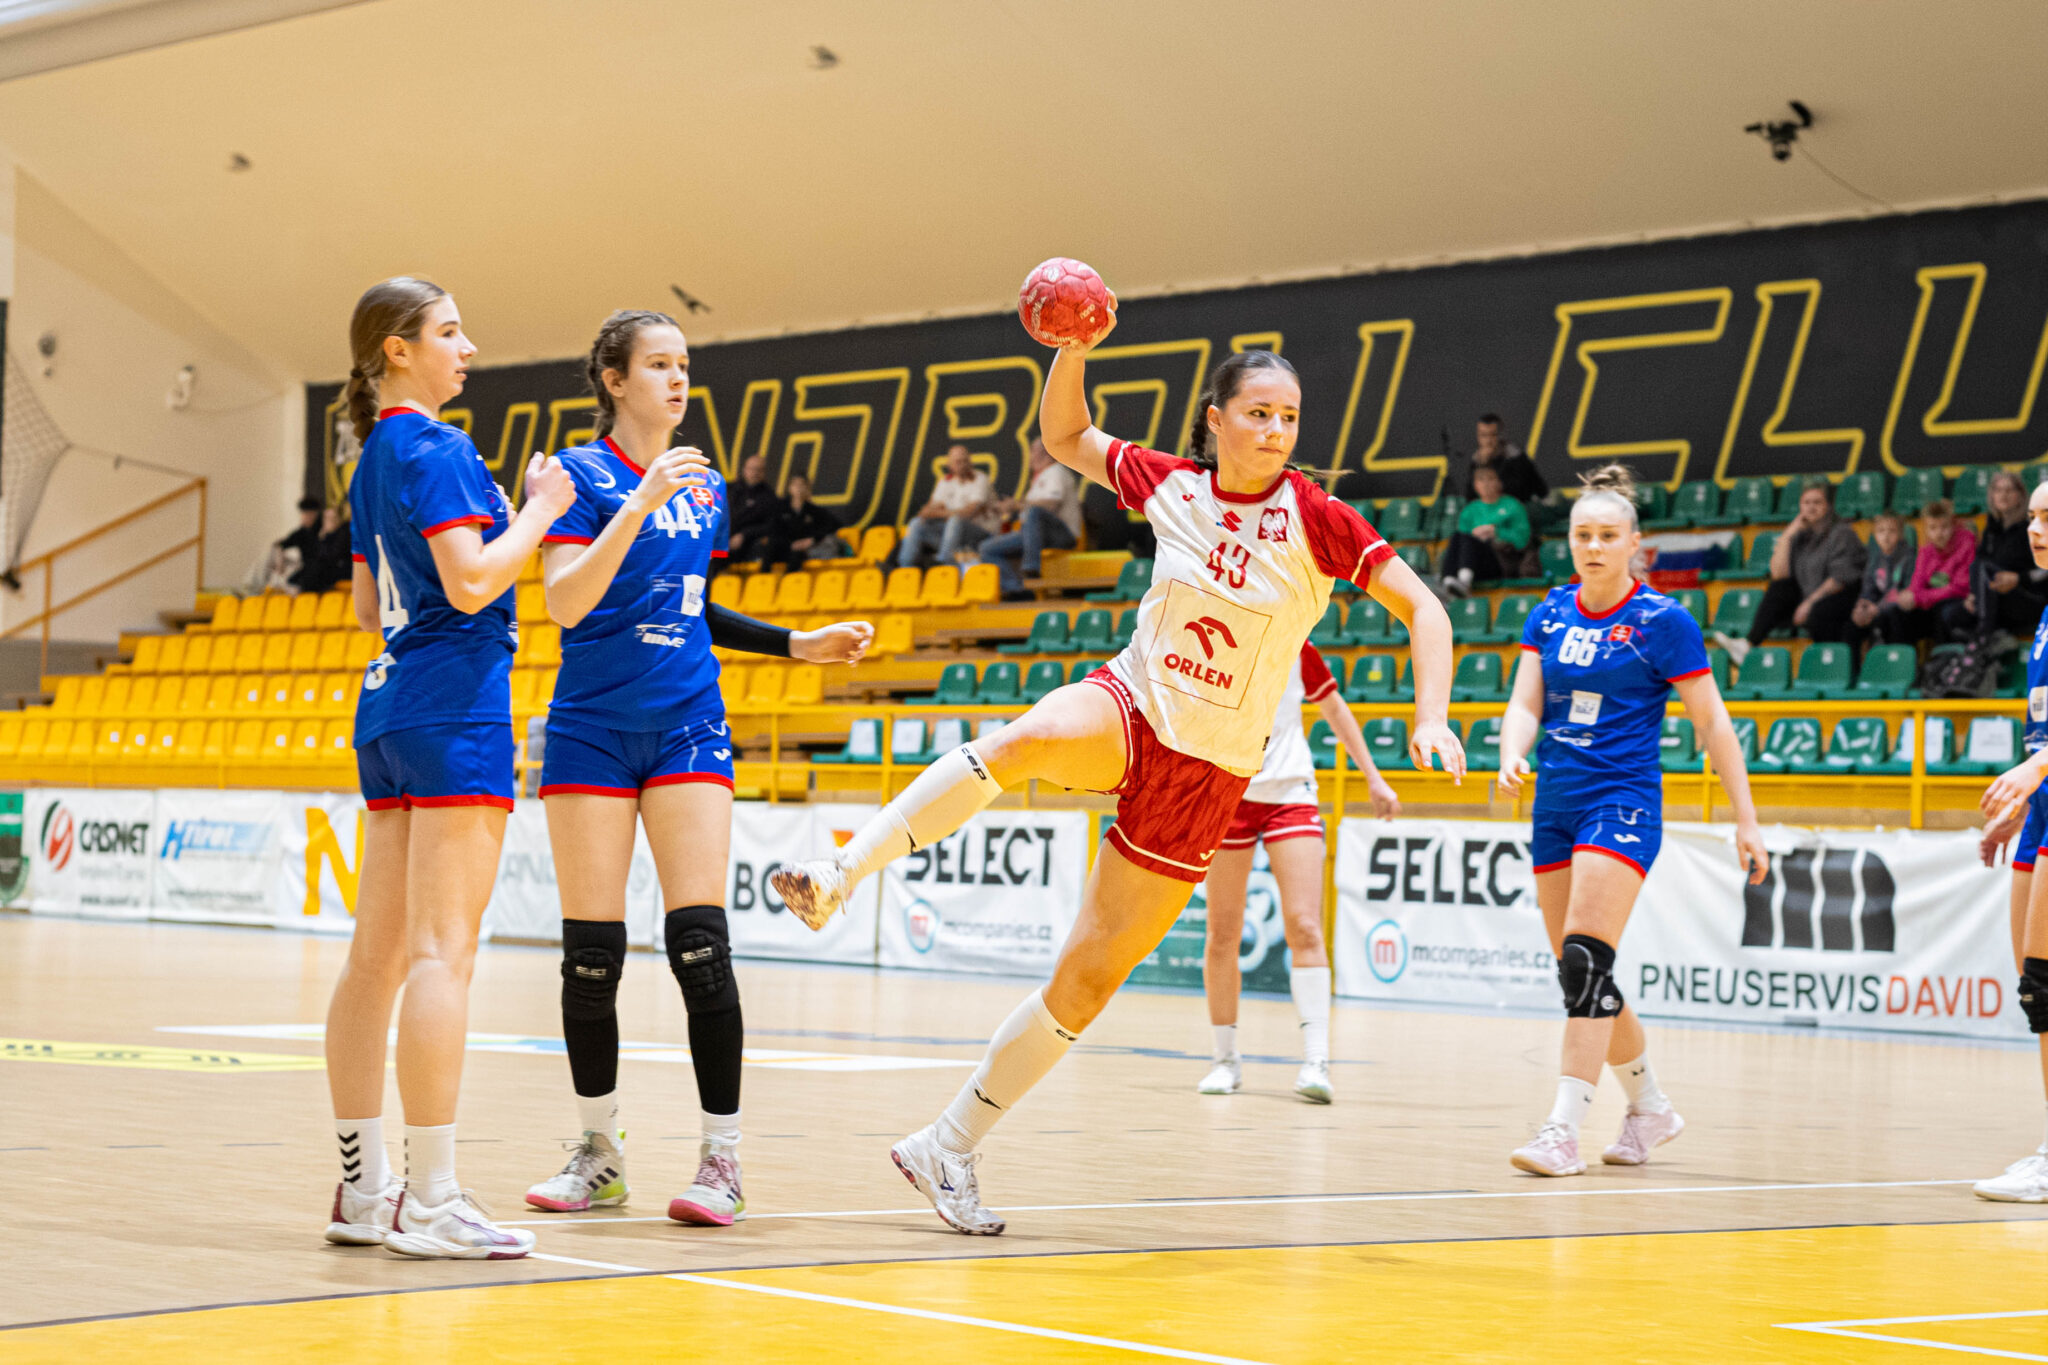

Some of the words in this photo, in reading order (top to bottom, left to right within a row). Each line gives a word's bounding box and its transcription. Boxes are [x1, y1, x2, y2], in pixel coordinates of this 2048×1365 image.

[654, 494, 703, 540] 44
[1206, 542, 1251, 589] 43
[1558, 626, 1602, 667] 66
[1164, 653, 1233, 690] ORLEN
[1367, 837, 1533, 906] SELEC
[1412, 944, 1552, 969] mcompanies.cz
